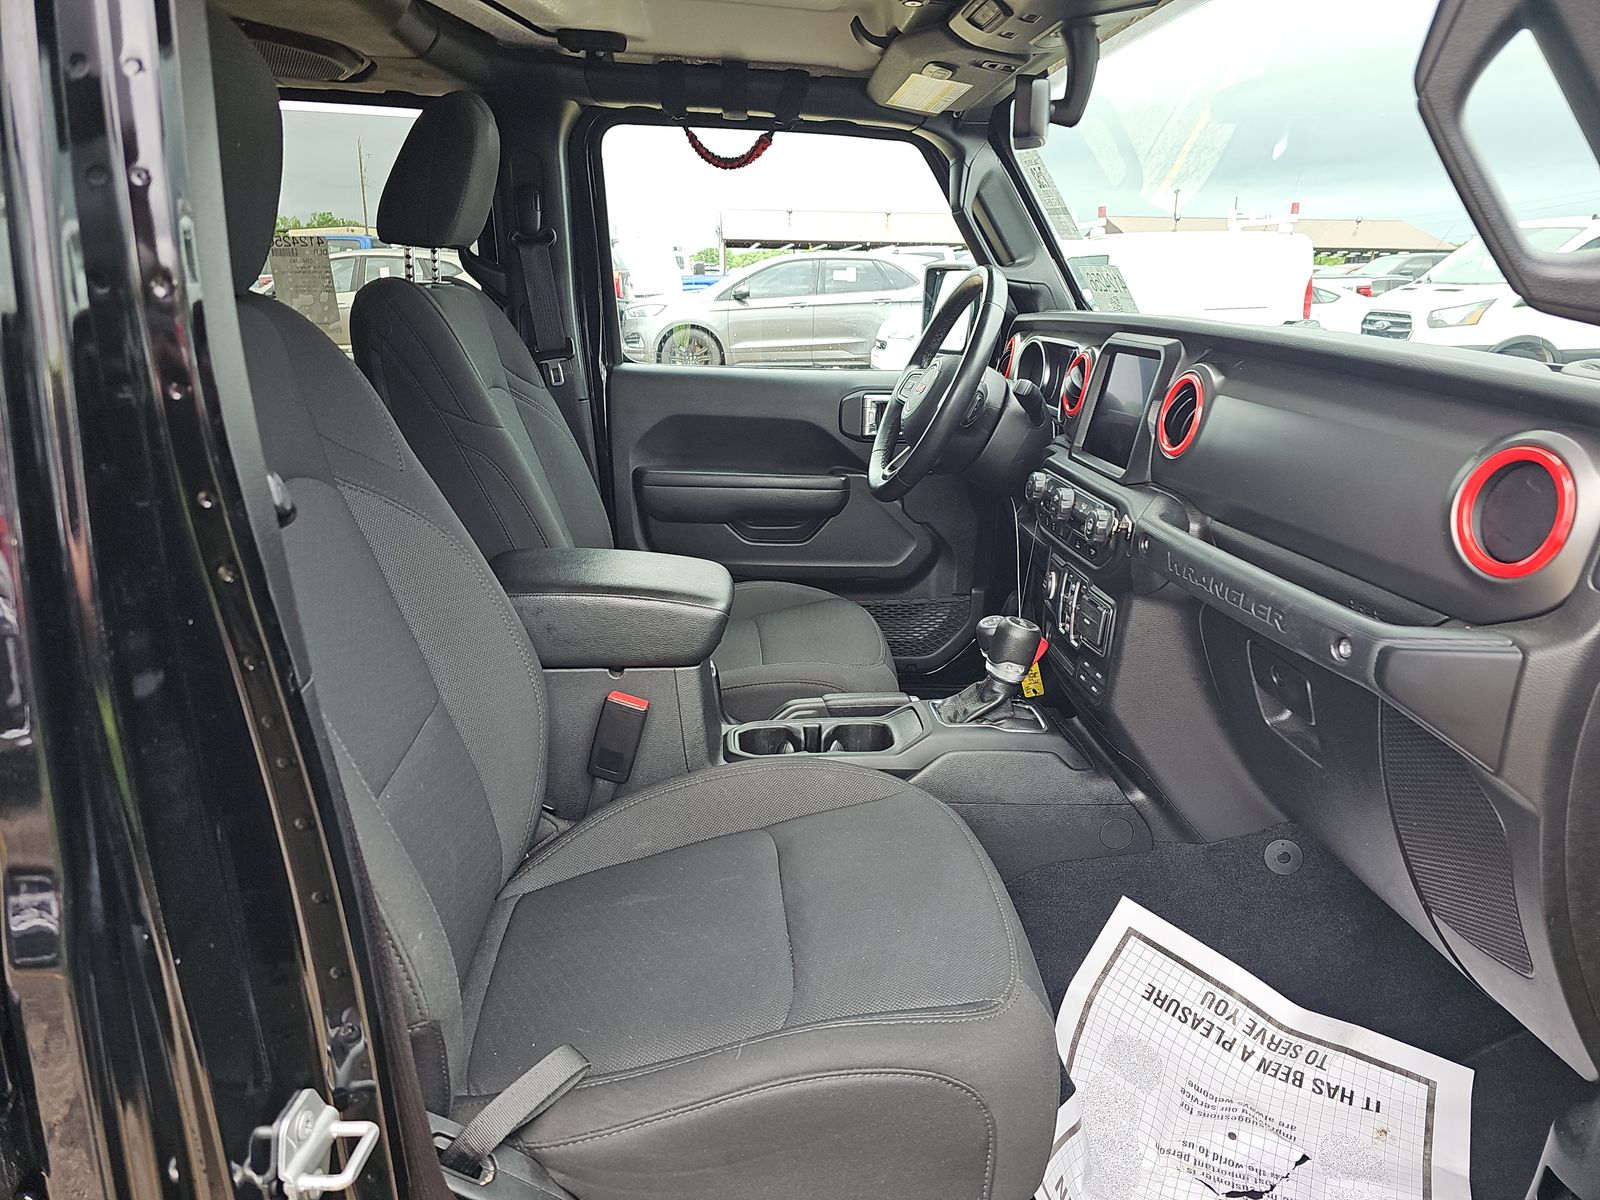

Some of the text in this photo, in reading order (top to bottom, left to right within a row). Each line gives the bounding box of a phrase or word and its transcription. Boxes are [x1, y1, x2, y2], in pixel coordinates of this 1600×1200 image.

[1167, 551, 1288, 634] WRANGLER
[1200, 991, 1329, 1072] TO SERVE YOU
[1141, 982, 1381, 1114] IT HAS BEEN A PLEASURE
[1179, 1087, 1217, 1112] service
[1219, 1105, 1238, 1114] our
[1179, 1100, 1265, 1129] suggestions for
[1278, 1120, 1297, 1132] are
[1155, 1141, 1191, 1163] person
[1178, 1139, 1195, 1151] us.
[1198, 1145, 1209, 1158] to
[1193, 1158, 1250, 1183] important
[1212, 1152, 1244, 1170] world
[1248, 1165, 1267, 1177] the
